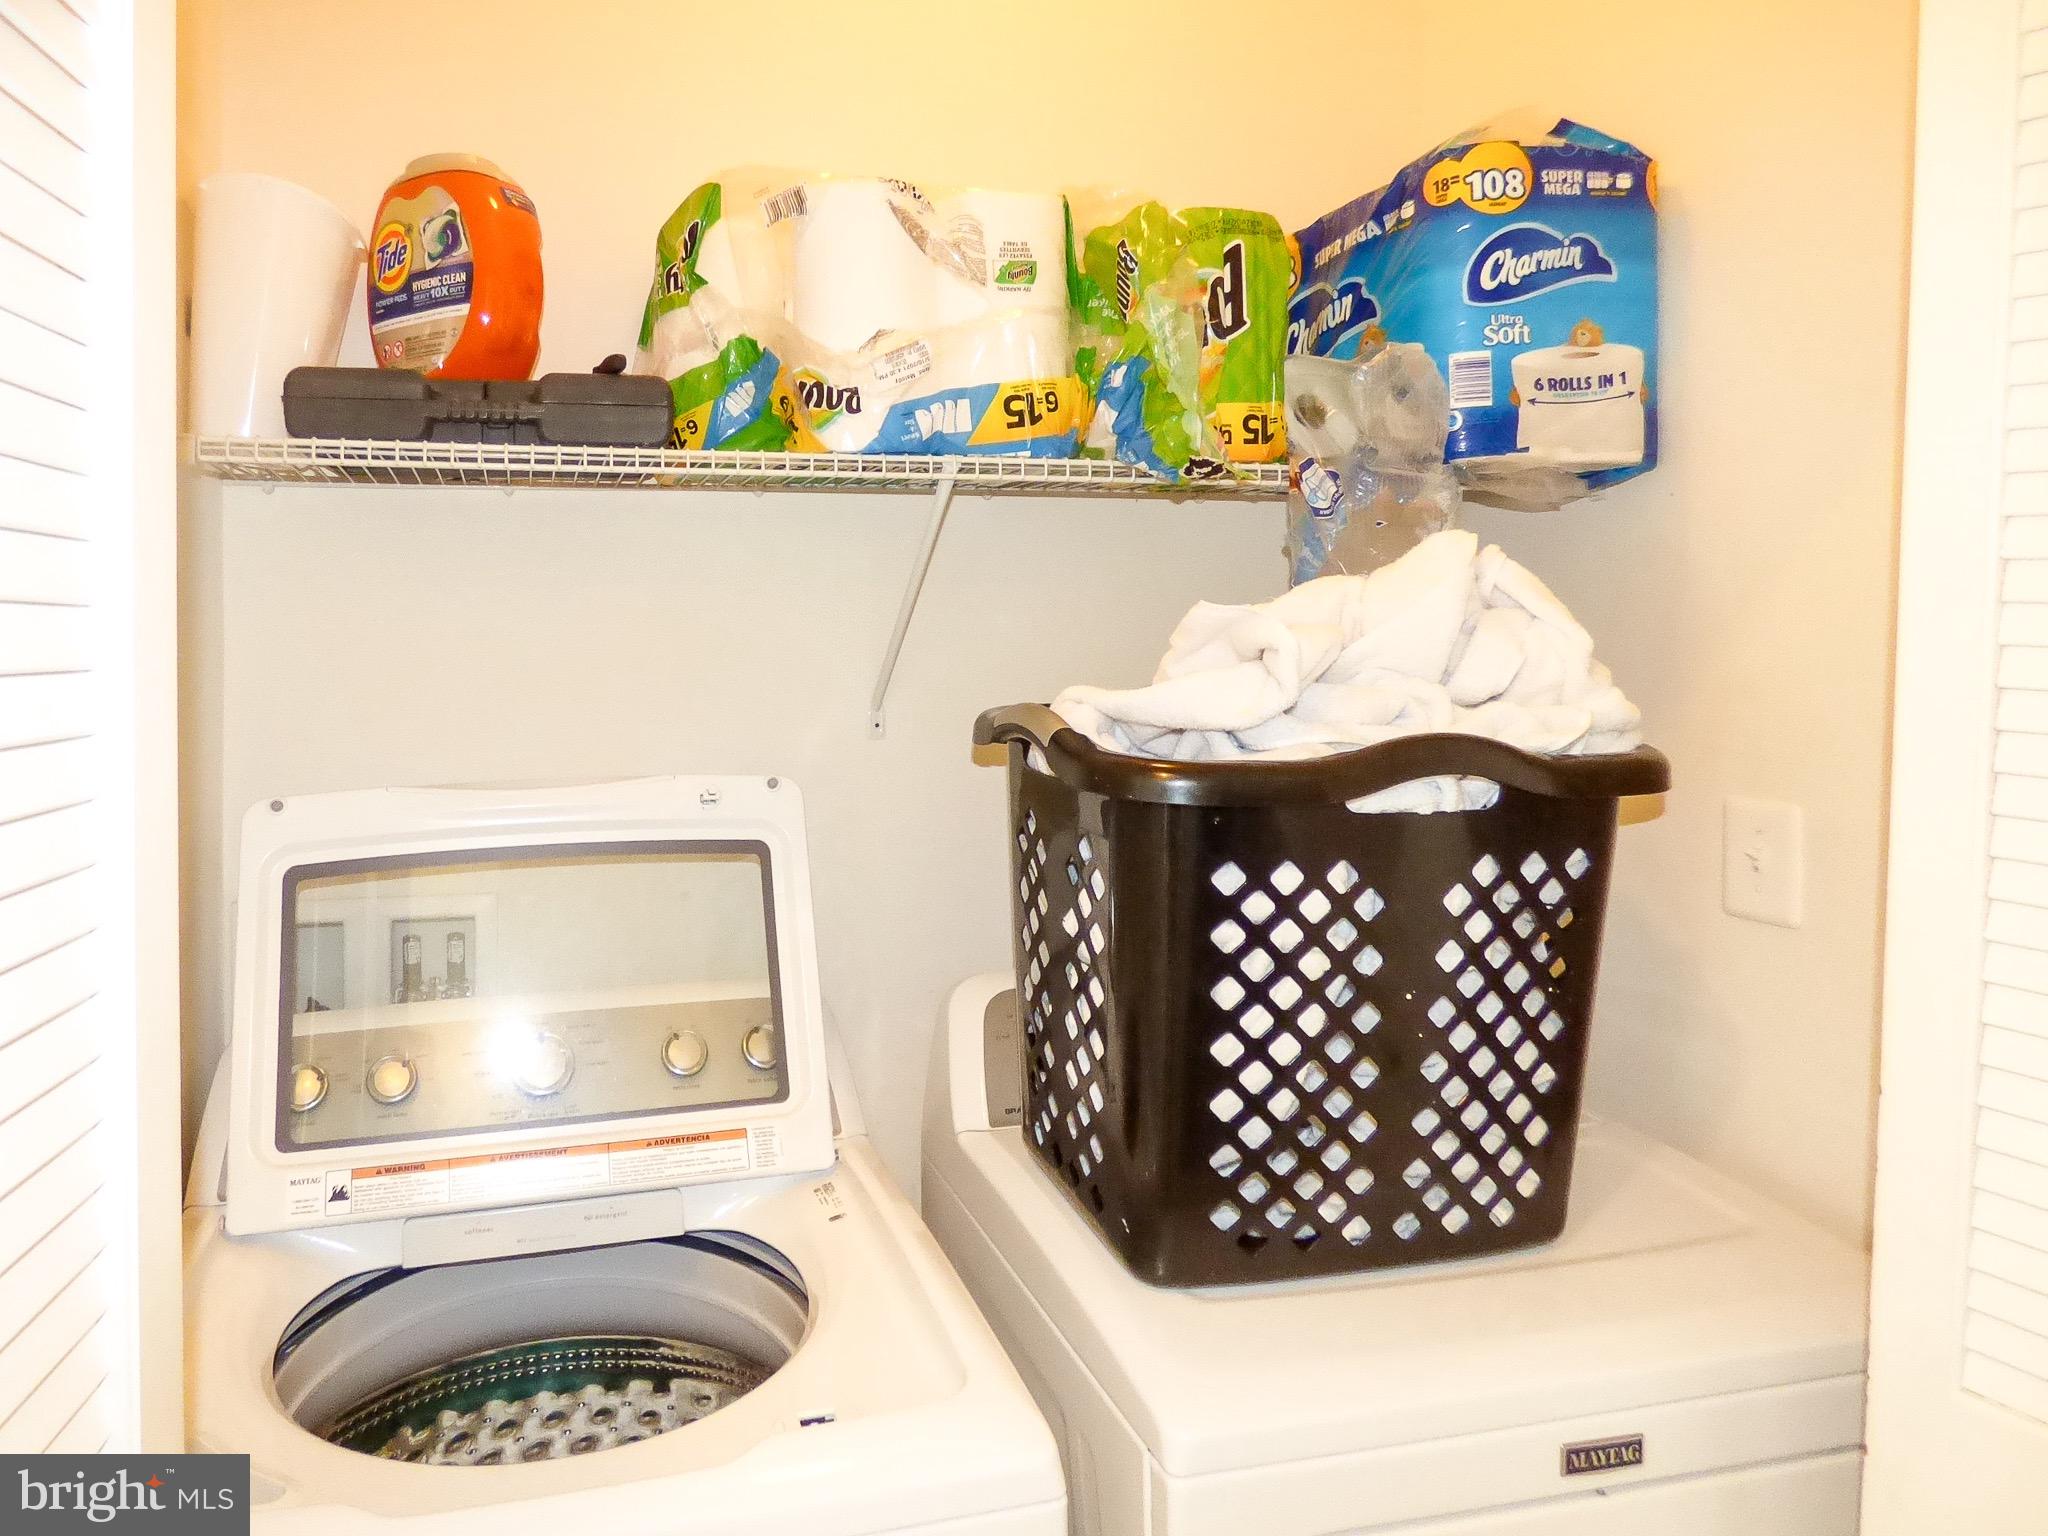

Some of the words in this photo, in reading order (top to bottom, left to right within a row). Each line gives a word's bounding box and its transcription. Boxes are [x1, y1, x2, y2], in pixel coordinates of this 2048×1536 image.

[1463, 167, 1525, 202] 108
[1541, 169, 1584, 184] SUPER
[1544, 183, 1581, 195] MEGA
[377, 239, 408, 283] Tide
[1480, 239, 1583, 291] Charmin
[1007, 266, 1033, 280] Bounty
[412, 277, 441, 292] HYGIENIC
[442, 272, 466, 286] CLEAN
[430, 285, 449, 299] 10X
[449, 286, 466, 294] DUTY
[1286, 289, 1353, 355] Chamin
[1491, 314, 1523, 325] Ultra
[1483, 324, 1532, 346] Soft
[1534, 377, 1544, 392] 6
[1547, 376, 1592, 392] ROLLS
[1598, 373, 1614, 389] IN
[1618, 371, 1627, 385] 1
[653, 1134, 710, 1146] ADVERTENCIA
[384, 1164, 426, 1174] WARNING
[289, 1177, 321, 1186] MAYTAG
[1568, 1444, 1641, 1470] MAYTAG
